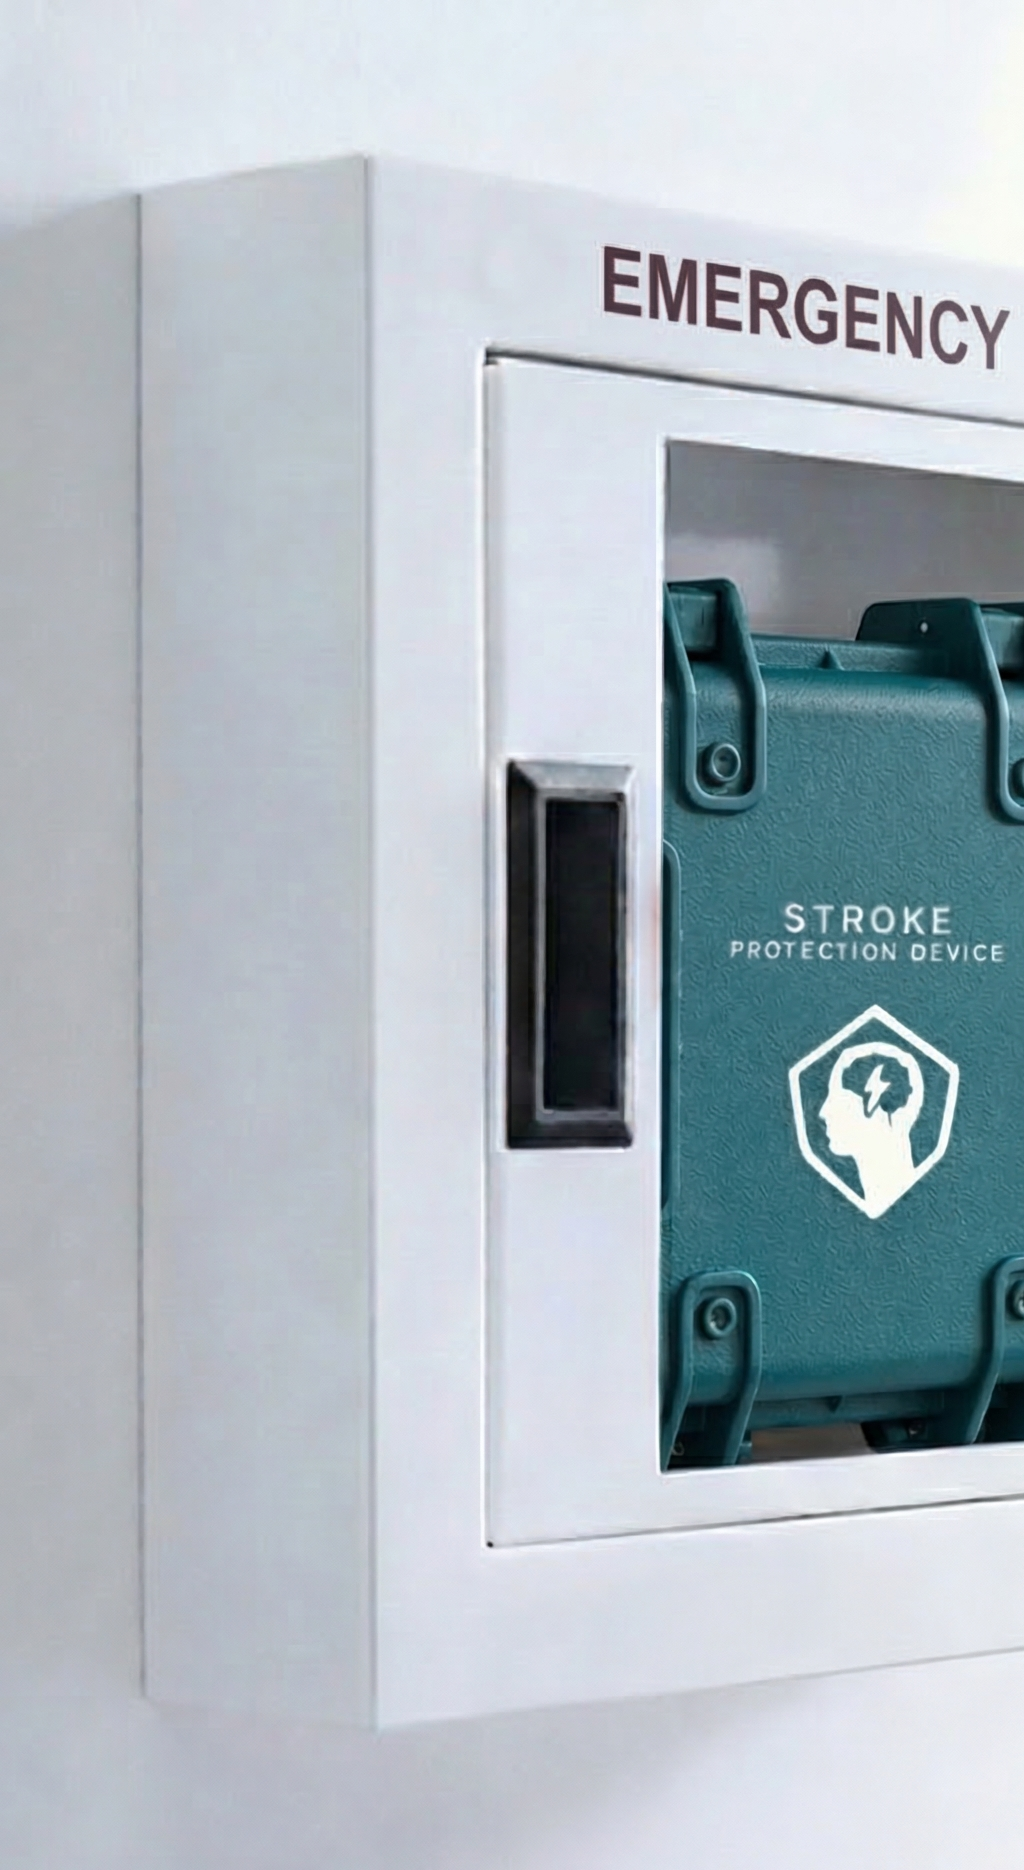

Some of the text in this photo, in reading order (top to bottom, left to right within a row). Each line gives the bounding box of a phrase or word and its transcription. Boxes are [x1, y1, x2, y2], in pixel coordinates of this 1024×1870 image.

[602, 245, 1011, 371] EMERGENCY
[783, 902, 953, 935] STROKE
[730, 939, 1005, 964] PROTECTION DEVICE
